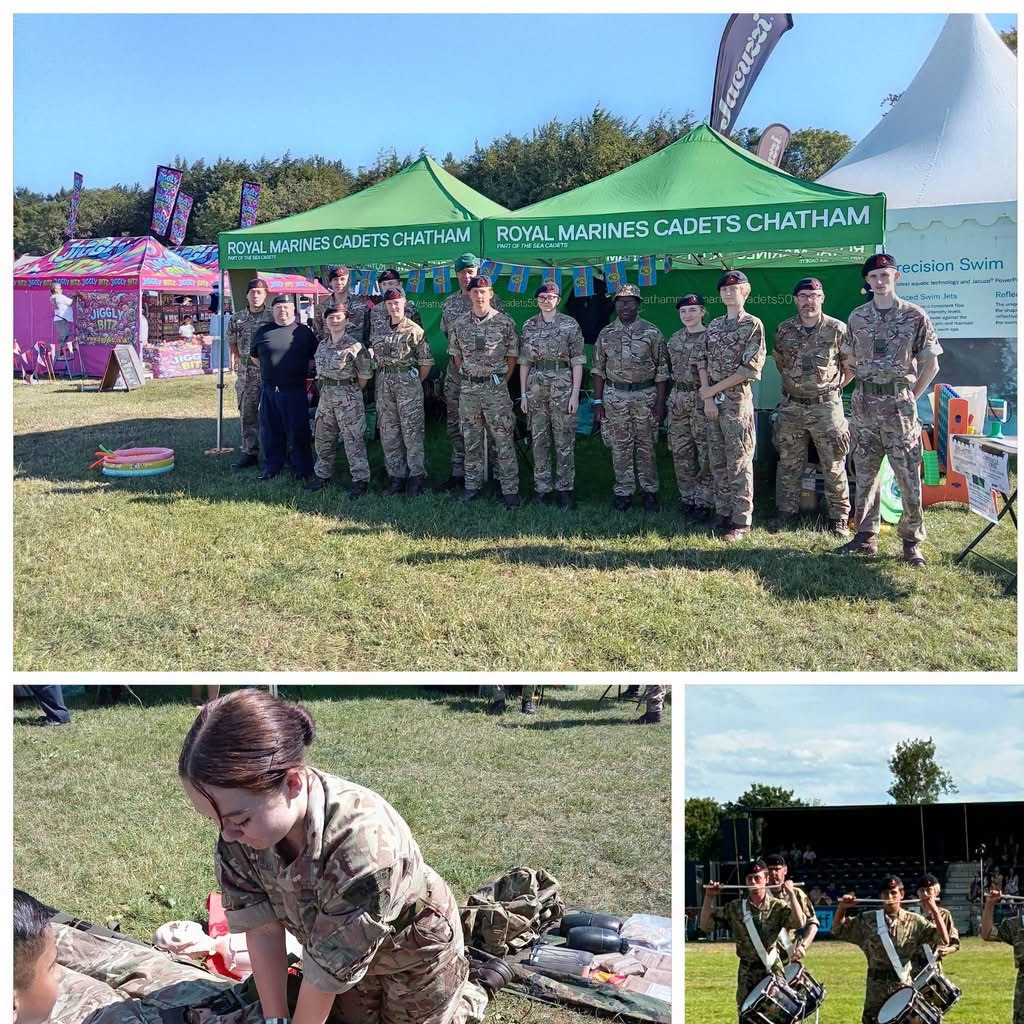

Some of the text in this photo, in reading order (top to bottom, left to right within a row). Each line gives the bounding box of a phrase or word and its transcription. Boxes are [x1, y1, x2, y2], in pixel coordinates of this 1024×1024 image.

[719, 13, 773, 131] Jacuzzi
[496, 205, 870, 242] ROYAL MARINES CADETS CHATHAM
[228, 226, 471, 255] ROYAL MARINES CADETS CHATHAM
[897, 257, 1004, 273] recision Swim
[931, 279, 960, 287] technology
[920, 292, 940, 301] Swim
[943, 292, 958, 300] Jets
[91, 306, 124, 320] JIGGLY
[97, 318, 118, 331] BITZ
